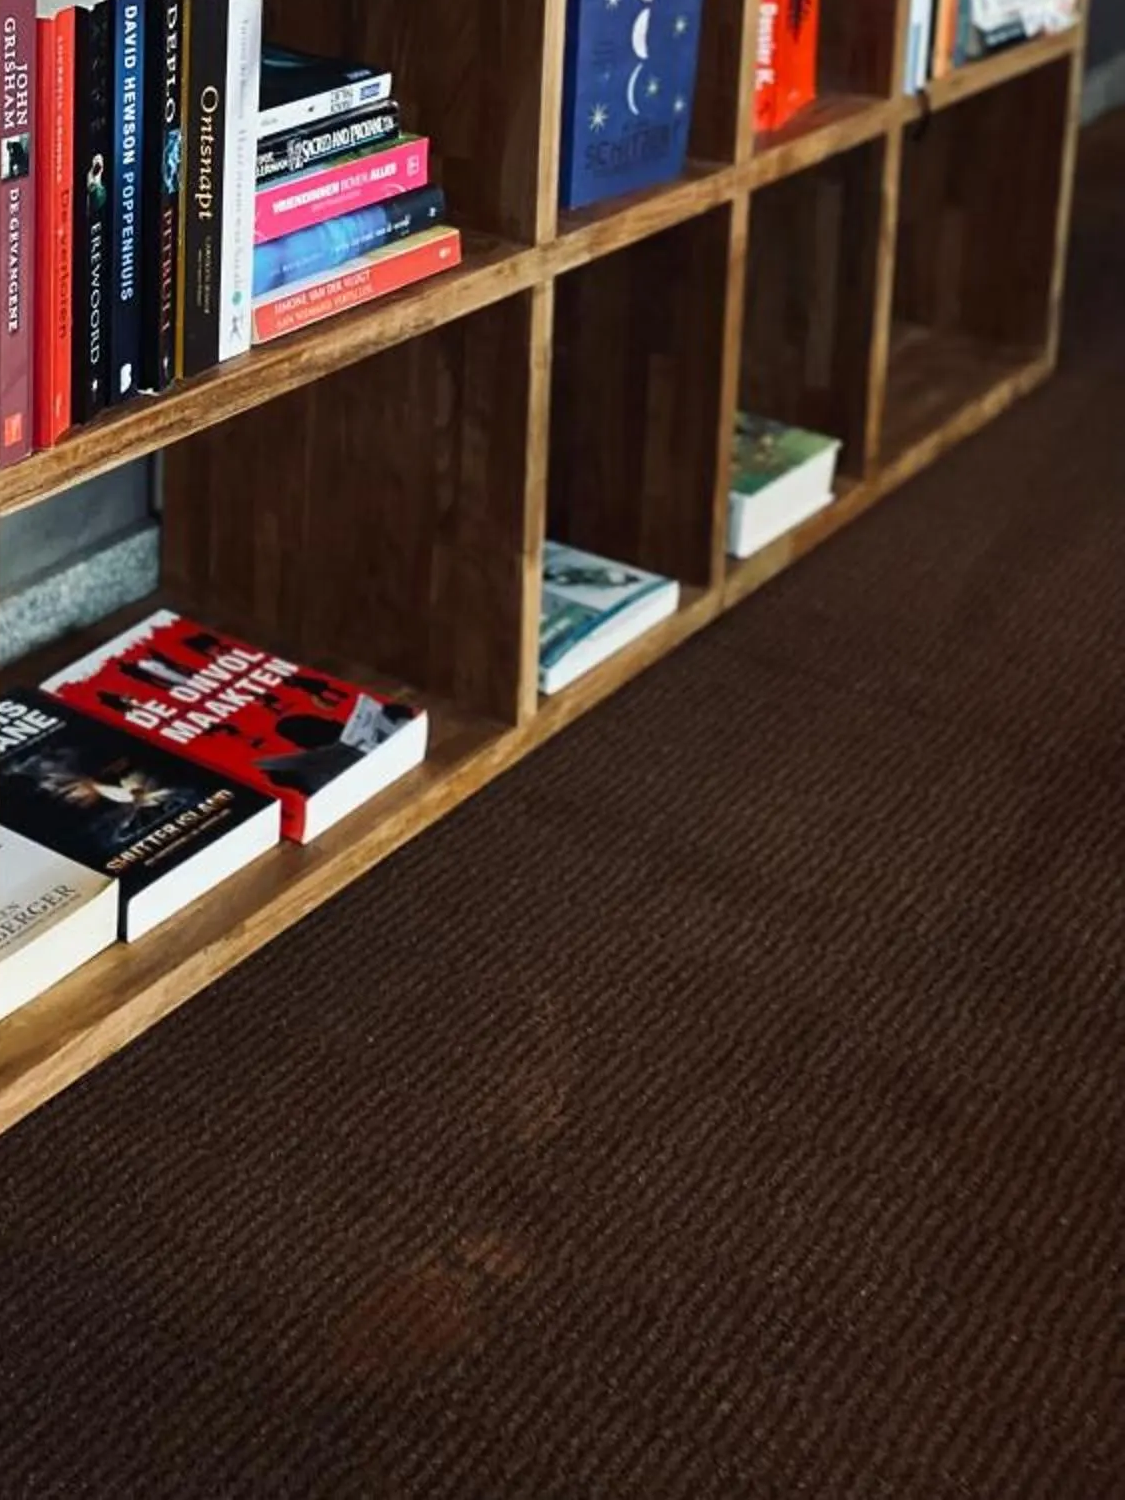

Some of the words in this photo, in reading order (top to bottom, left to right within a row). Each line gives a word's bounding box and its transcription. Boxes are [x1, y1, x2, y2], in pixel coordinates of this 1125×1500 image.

[4, 17, 16, 129] GRISHAM
[124, 5, 138, 69] DAVID
[165, 3, 178, 124] DEFLO
[15, 64, 28, 125] JOHN
[123, 77, 136, 165] HEWSON
[195, 85, 219, 221] Ontsnapt
[120, 171, 136, 301] POPPENHUIS
[91, 221, 103, 365] EREWOORD
[125, 699, 179, 730] DE
[169, 647, 266, 703] ONVOL
[159, 657, 300, 745] MAAKTEN
[105, 822, 182, 874] SHUTTER
[175, 788, 235, 827] ISLAND
